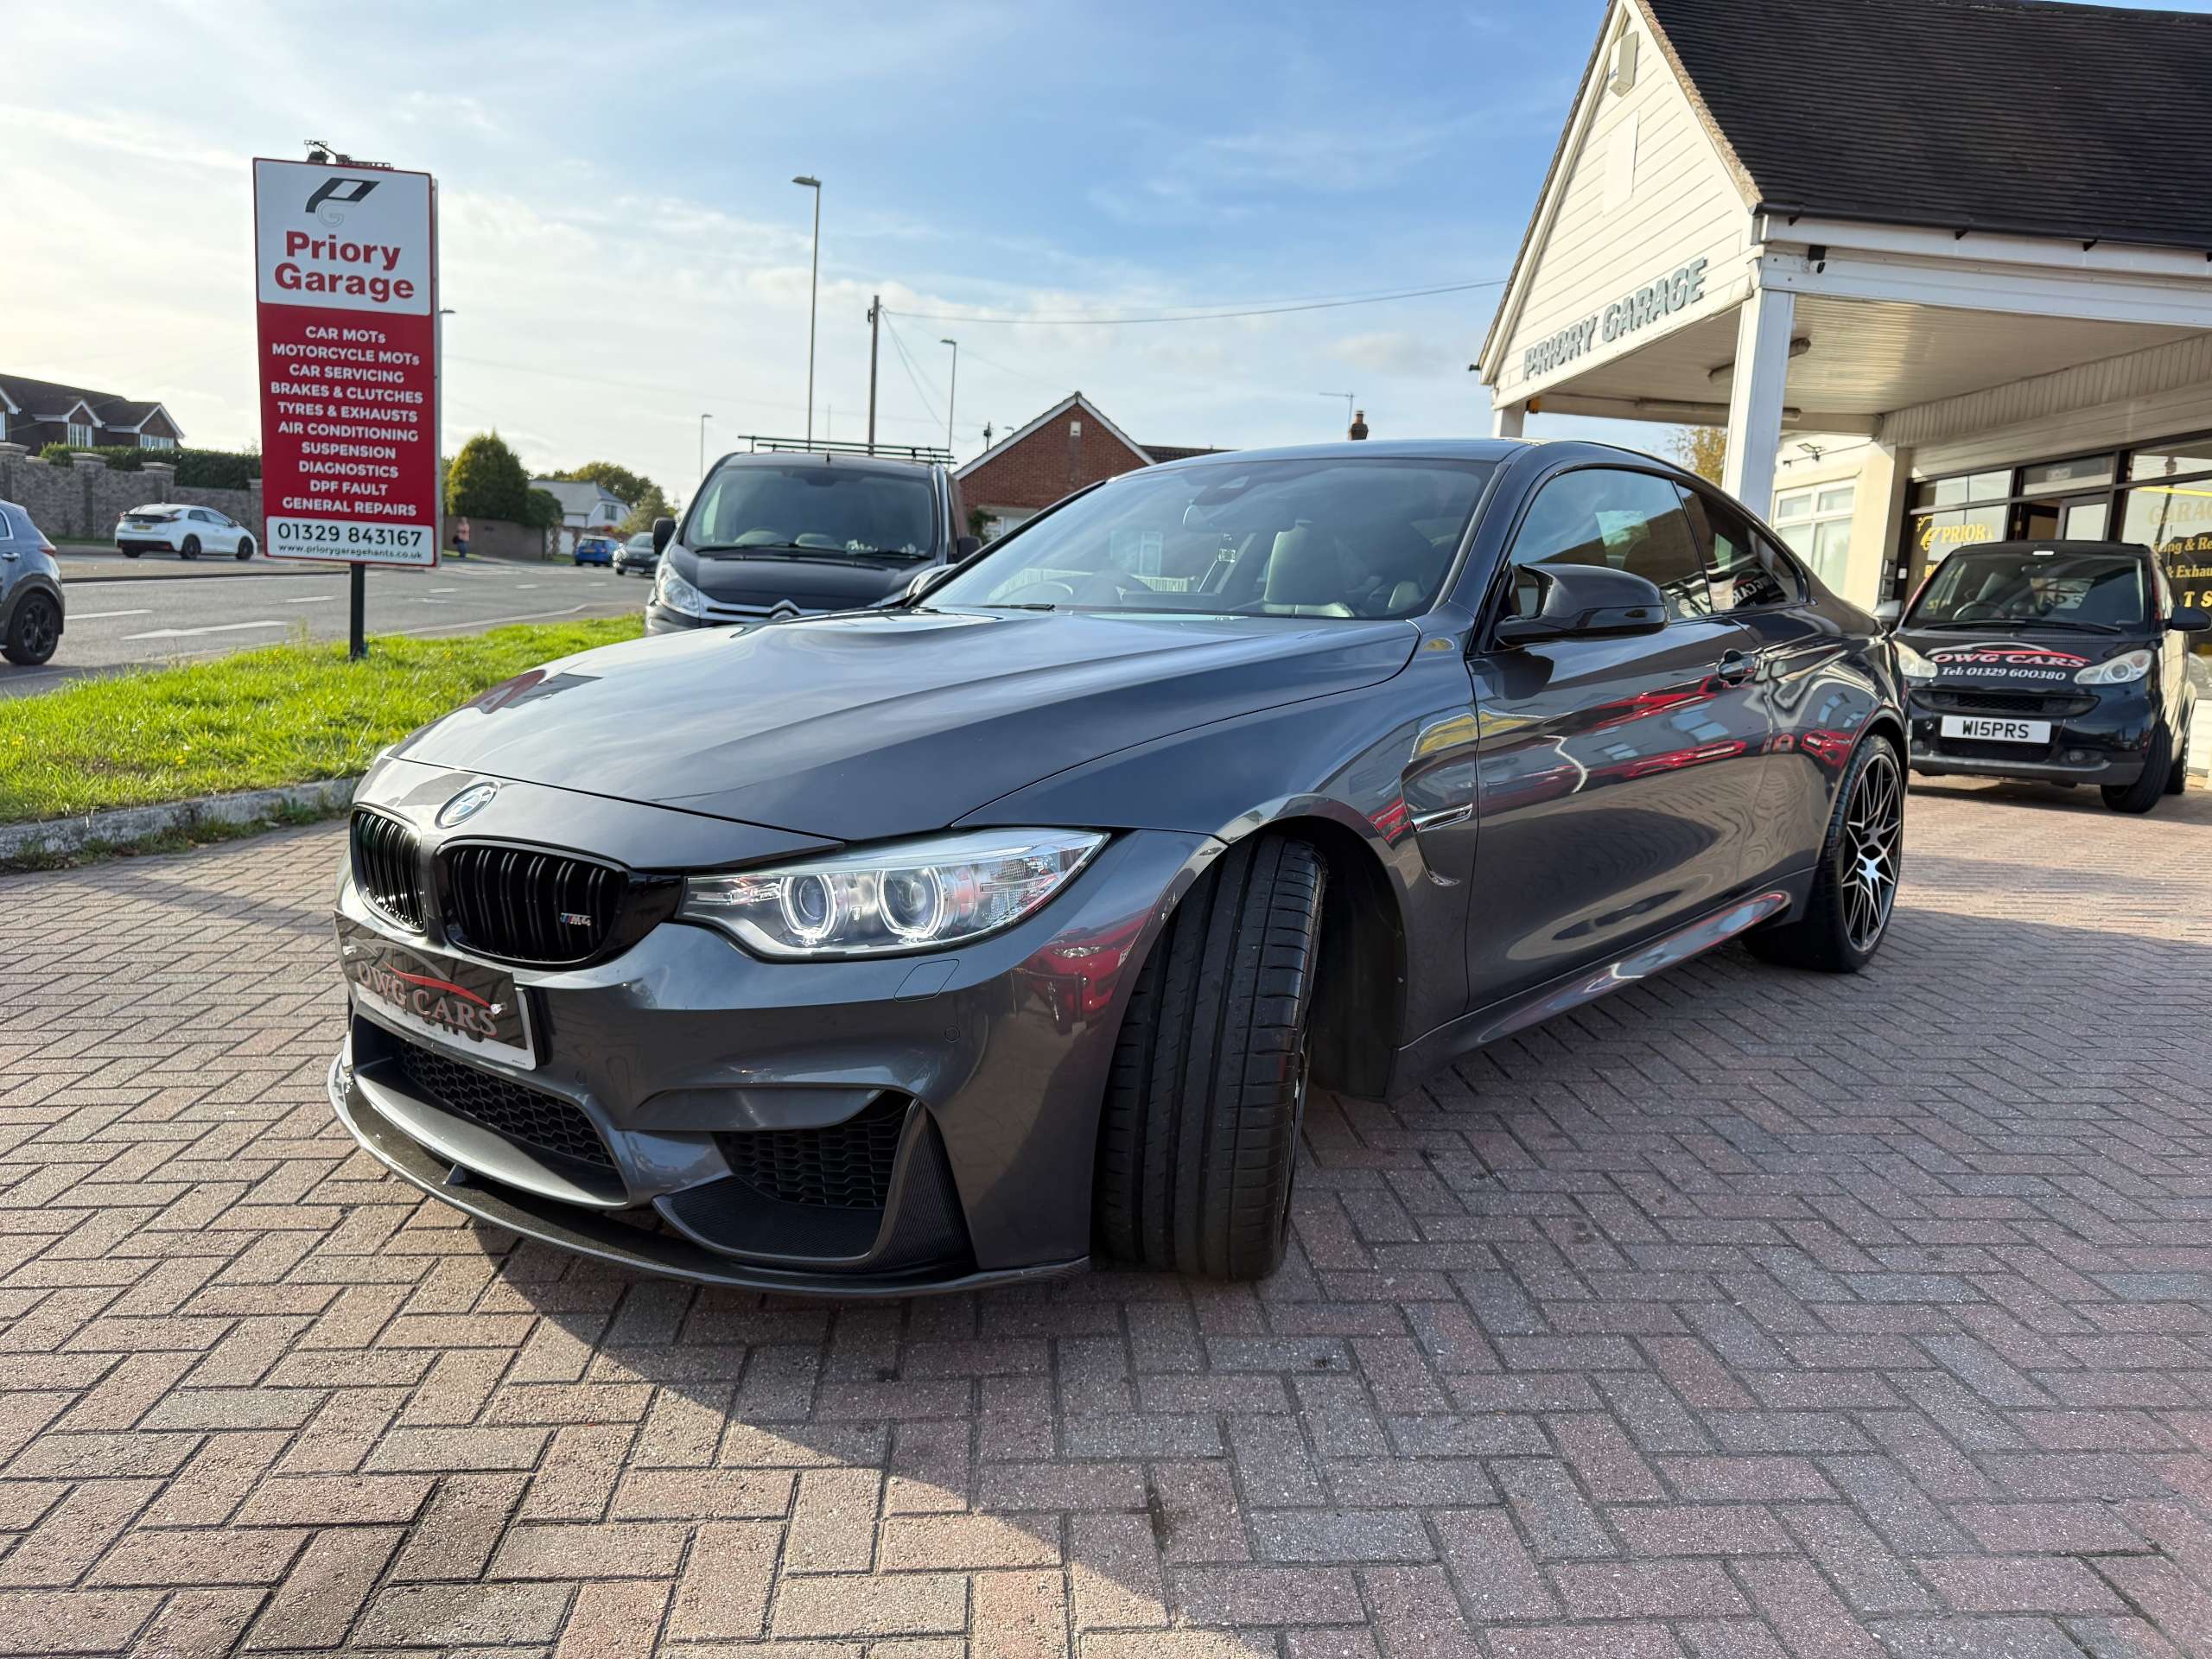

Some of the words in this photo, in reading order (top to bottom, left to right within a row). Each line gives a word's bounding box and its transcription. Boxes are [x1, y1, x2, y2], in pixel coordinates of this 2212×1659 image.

[286, 230, 401, 270] Priory
[275, 262, 414, 302] Garage
[1522, 315, 1599, 381] PRIORY
[1602, 257, 1707, 342] GARAGE
[306, 326, 338, 340] CAR
[343, 328, 386, 343] MOTs
[272, 343, 375, 362] MOTORCYCLE
[378, 351, 420, 365] MOTs
[289, 364, 321, 377] CAR
[324, 365, 404, 384] SERVICING
[271, 381, 329, 397] BRAKES
[333, 385, 343, 398] &
[346, 387, 423, 404] CLUTCHES
[277, 402, 323, 416] TYRES
[327, 405, 337, 417] &
[341, 406, 417, 423] EXHAUSTS
[278, 422, 303, 434] AIR
[308, 423, 418, 442] CONDITIONING
[302, 442, 397, 460] SUSPENSION
[299, 461, 398, 479] DIAGNOSTICS
[310, 480, 339, 493] DPF
[342, 481, 388, 496] FAULT
[283, 497, 351, 512] GENERAL
[354, 502, 416, 517] REPAIRS
[278, 523, 340, 541] 01329
[348, 527, 423, 546] 843167
[2184, 538, 2196, 550] &
[278, 543, 423, 560] www.priorygaragehants.co.uk
[1931, 653, 2000, 664] OWG
[2005, 654, 2085, 668] CARS
[1942, 666, 1964, 676] Tel:
[1966, 668, 2006, 677] 01329
[2009, 669, 2066, 681] 600380
[358, 961, 407, 1006] OWG
[412, 988, 499, 1037] CARS
